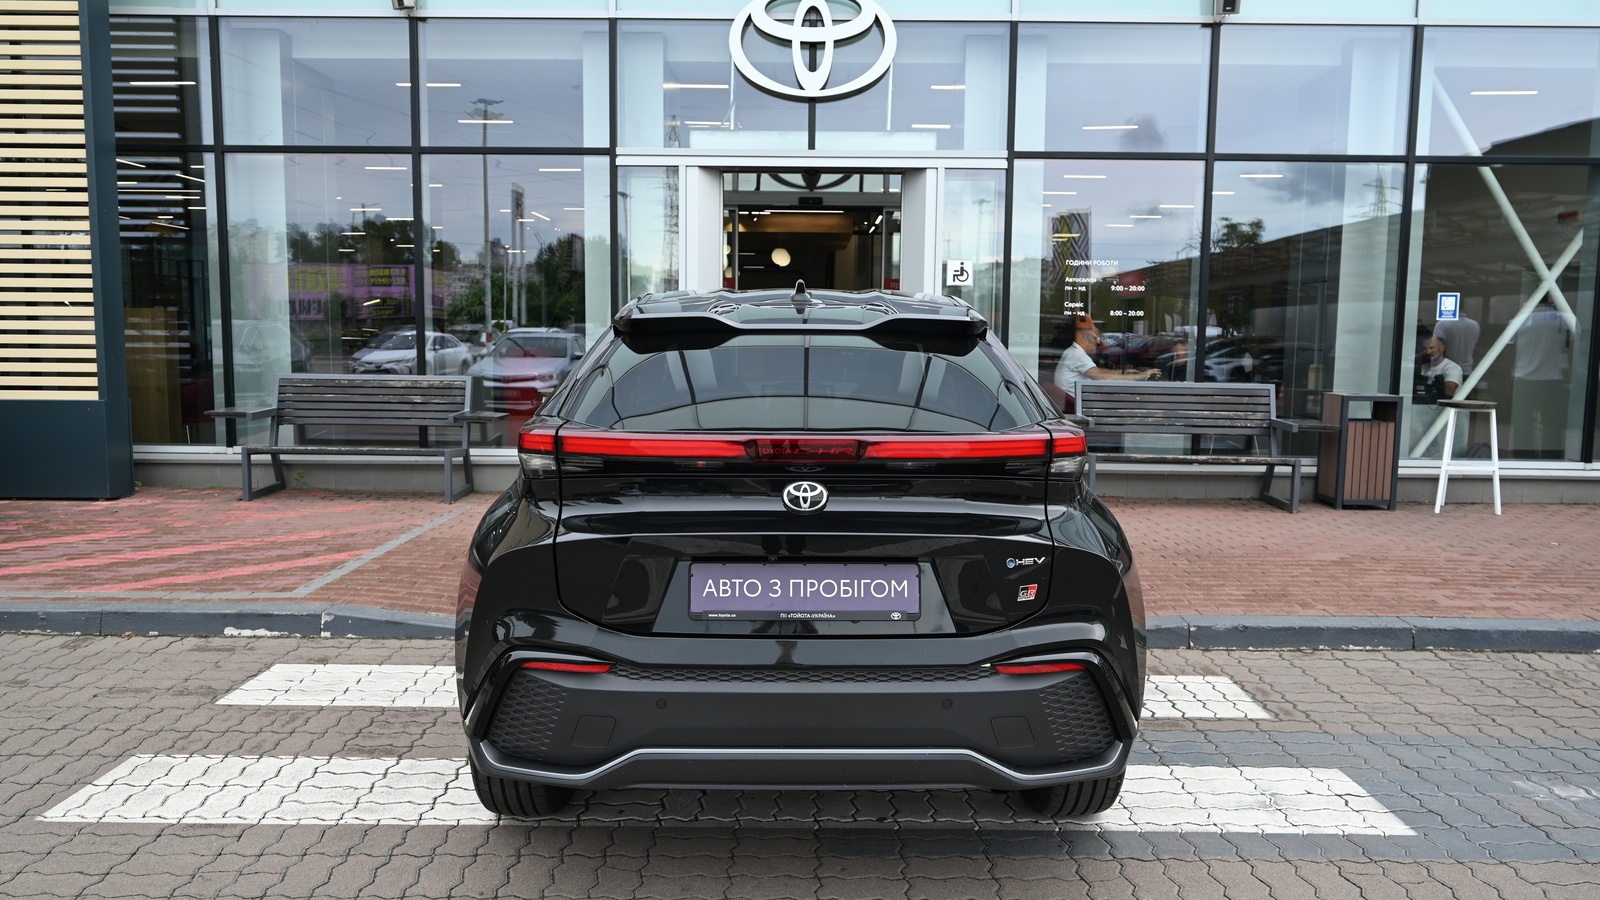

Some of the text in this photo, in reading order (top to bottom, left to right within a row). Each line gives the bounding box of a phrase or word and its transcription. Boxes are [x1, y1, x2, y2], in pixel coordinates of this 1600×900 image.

[1064, 301, 1084, 309] Сервіс
[1016, 557, 1046, 566] HEV
[702, 578, 908, 598] АВТО З ПРОБІГОМ
